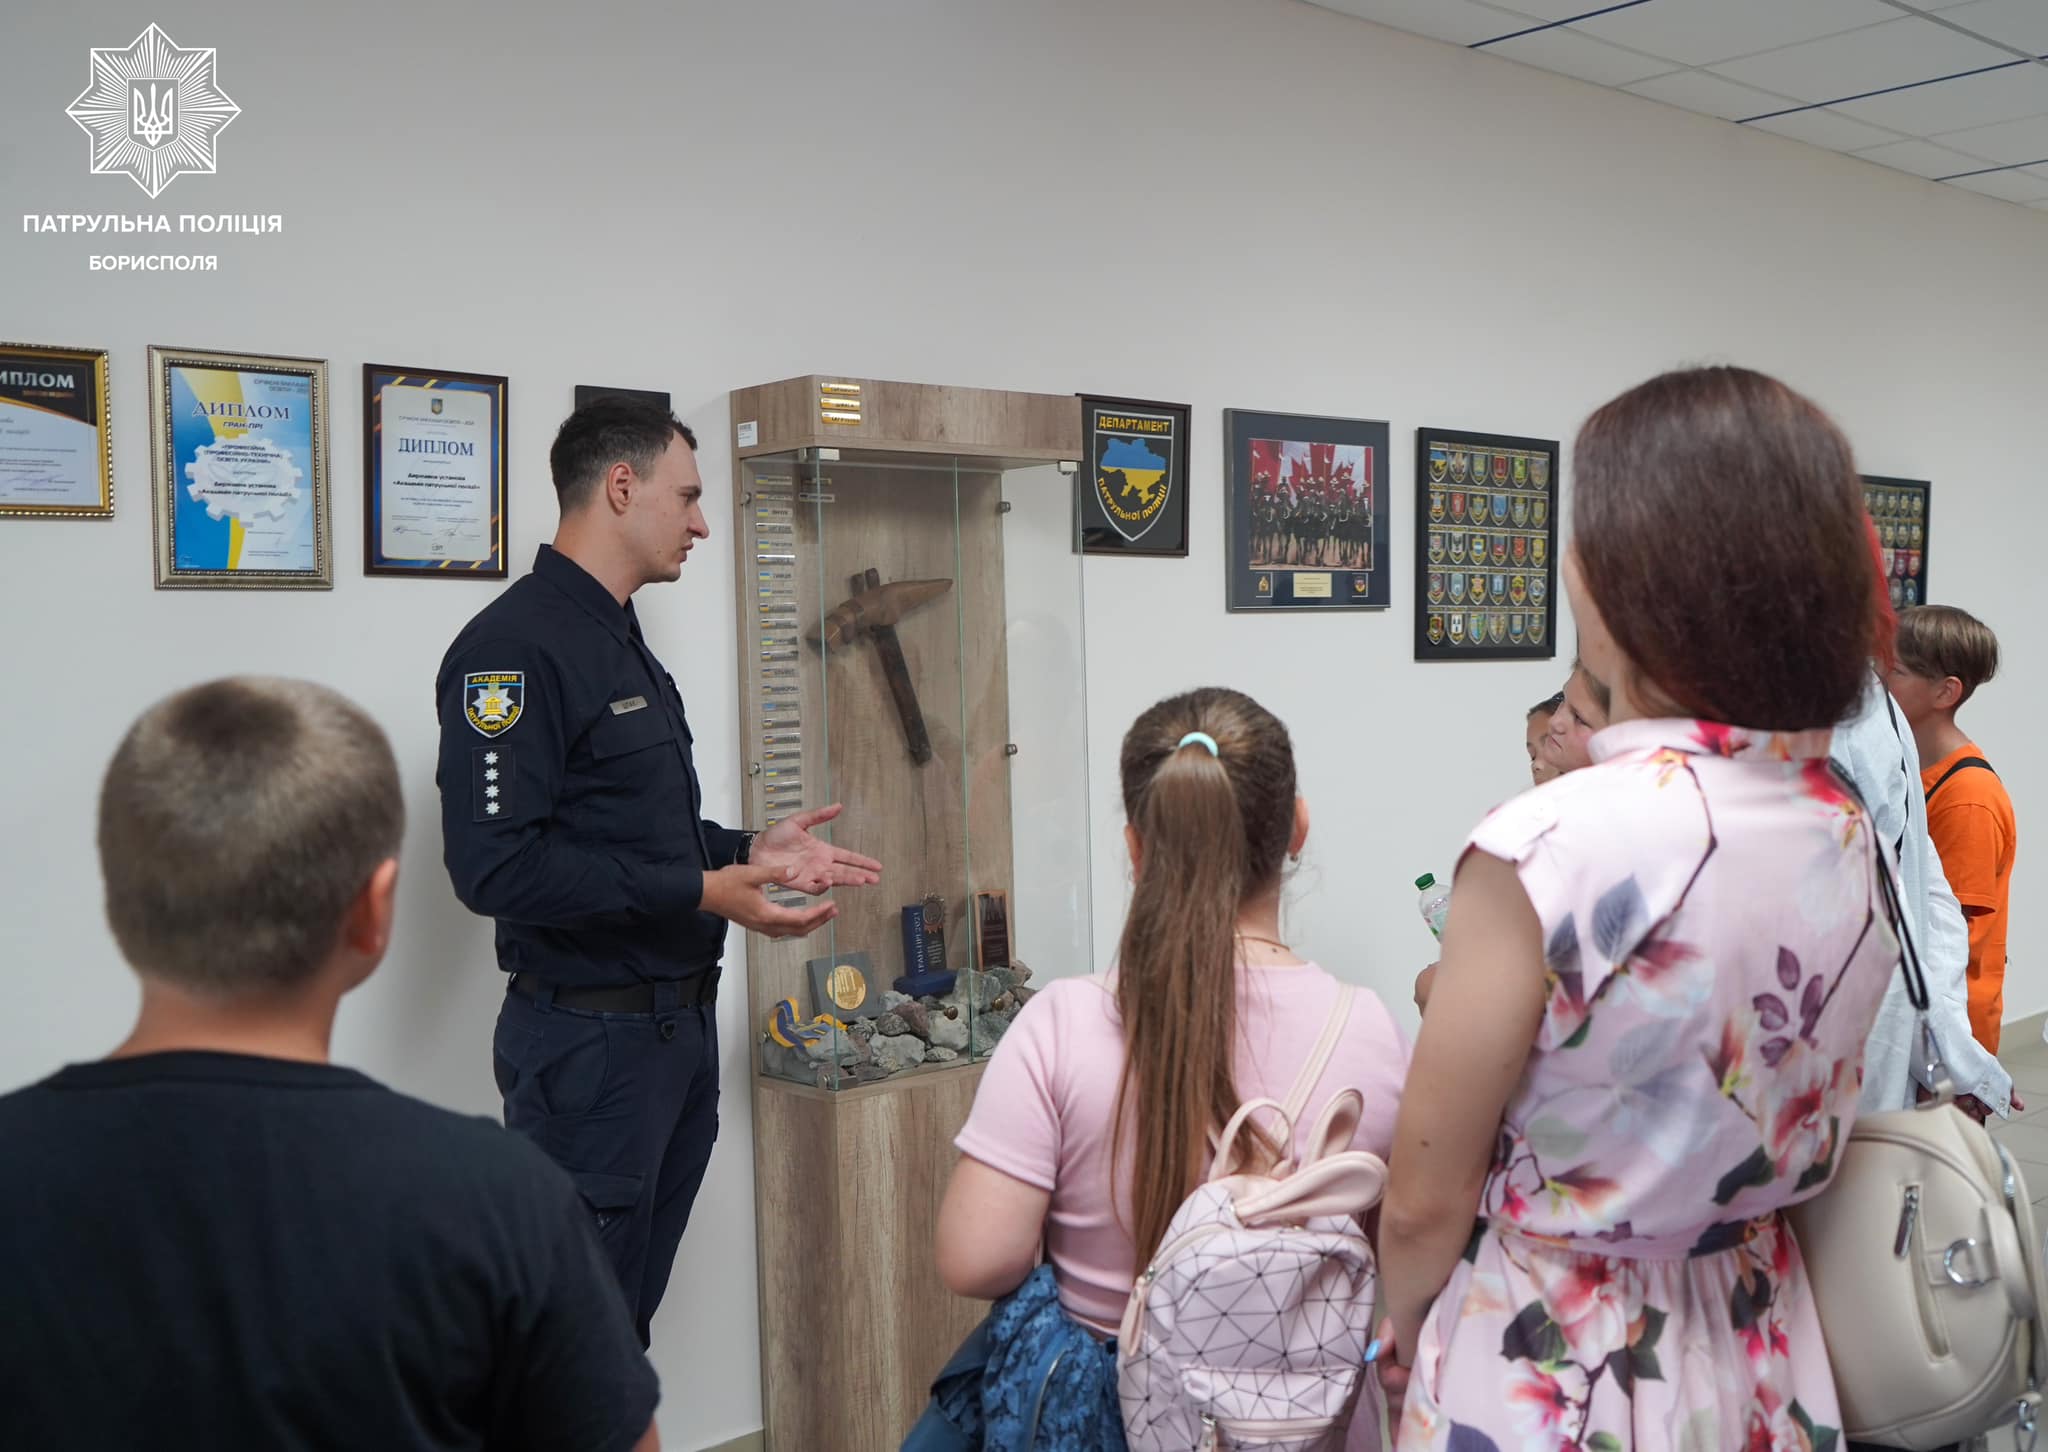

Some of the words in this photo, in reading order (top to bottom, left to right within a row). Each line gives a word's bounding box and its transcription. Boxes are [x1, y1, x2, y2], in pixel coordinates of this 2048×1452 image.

[192, 402, 290, 420] ДИПЛОМ
[1099, 416, 1169, 432] ДЕПАРТАМЕНТ
[398, 438, 474, 456] ДИПЛОМ
[1098, 477, 1141, 521] ПАТРУЛЬНОЇ
[1142, 484, 1168, 519] ПОЛІЦІЇ
[472, 675, 518, 683] АКАДЕМІЯ
